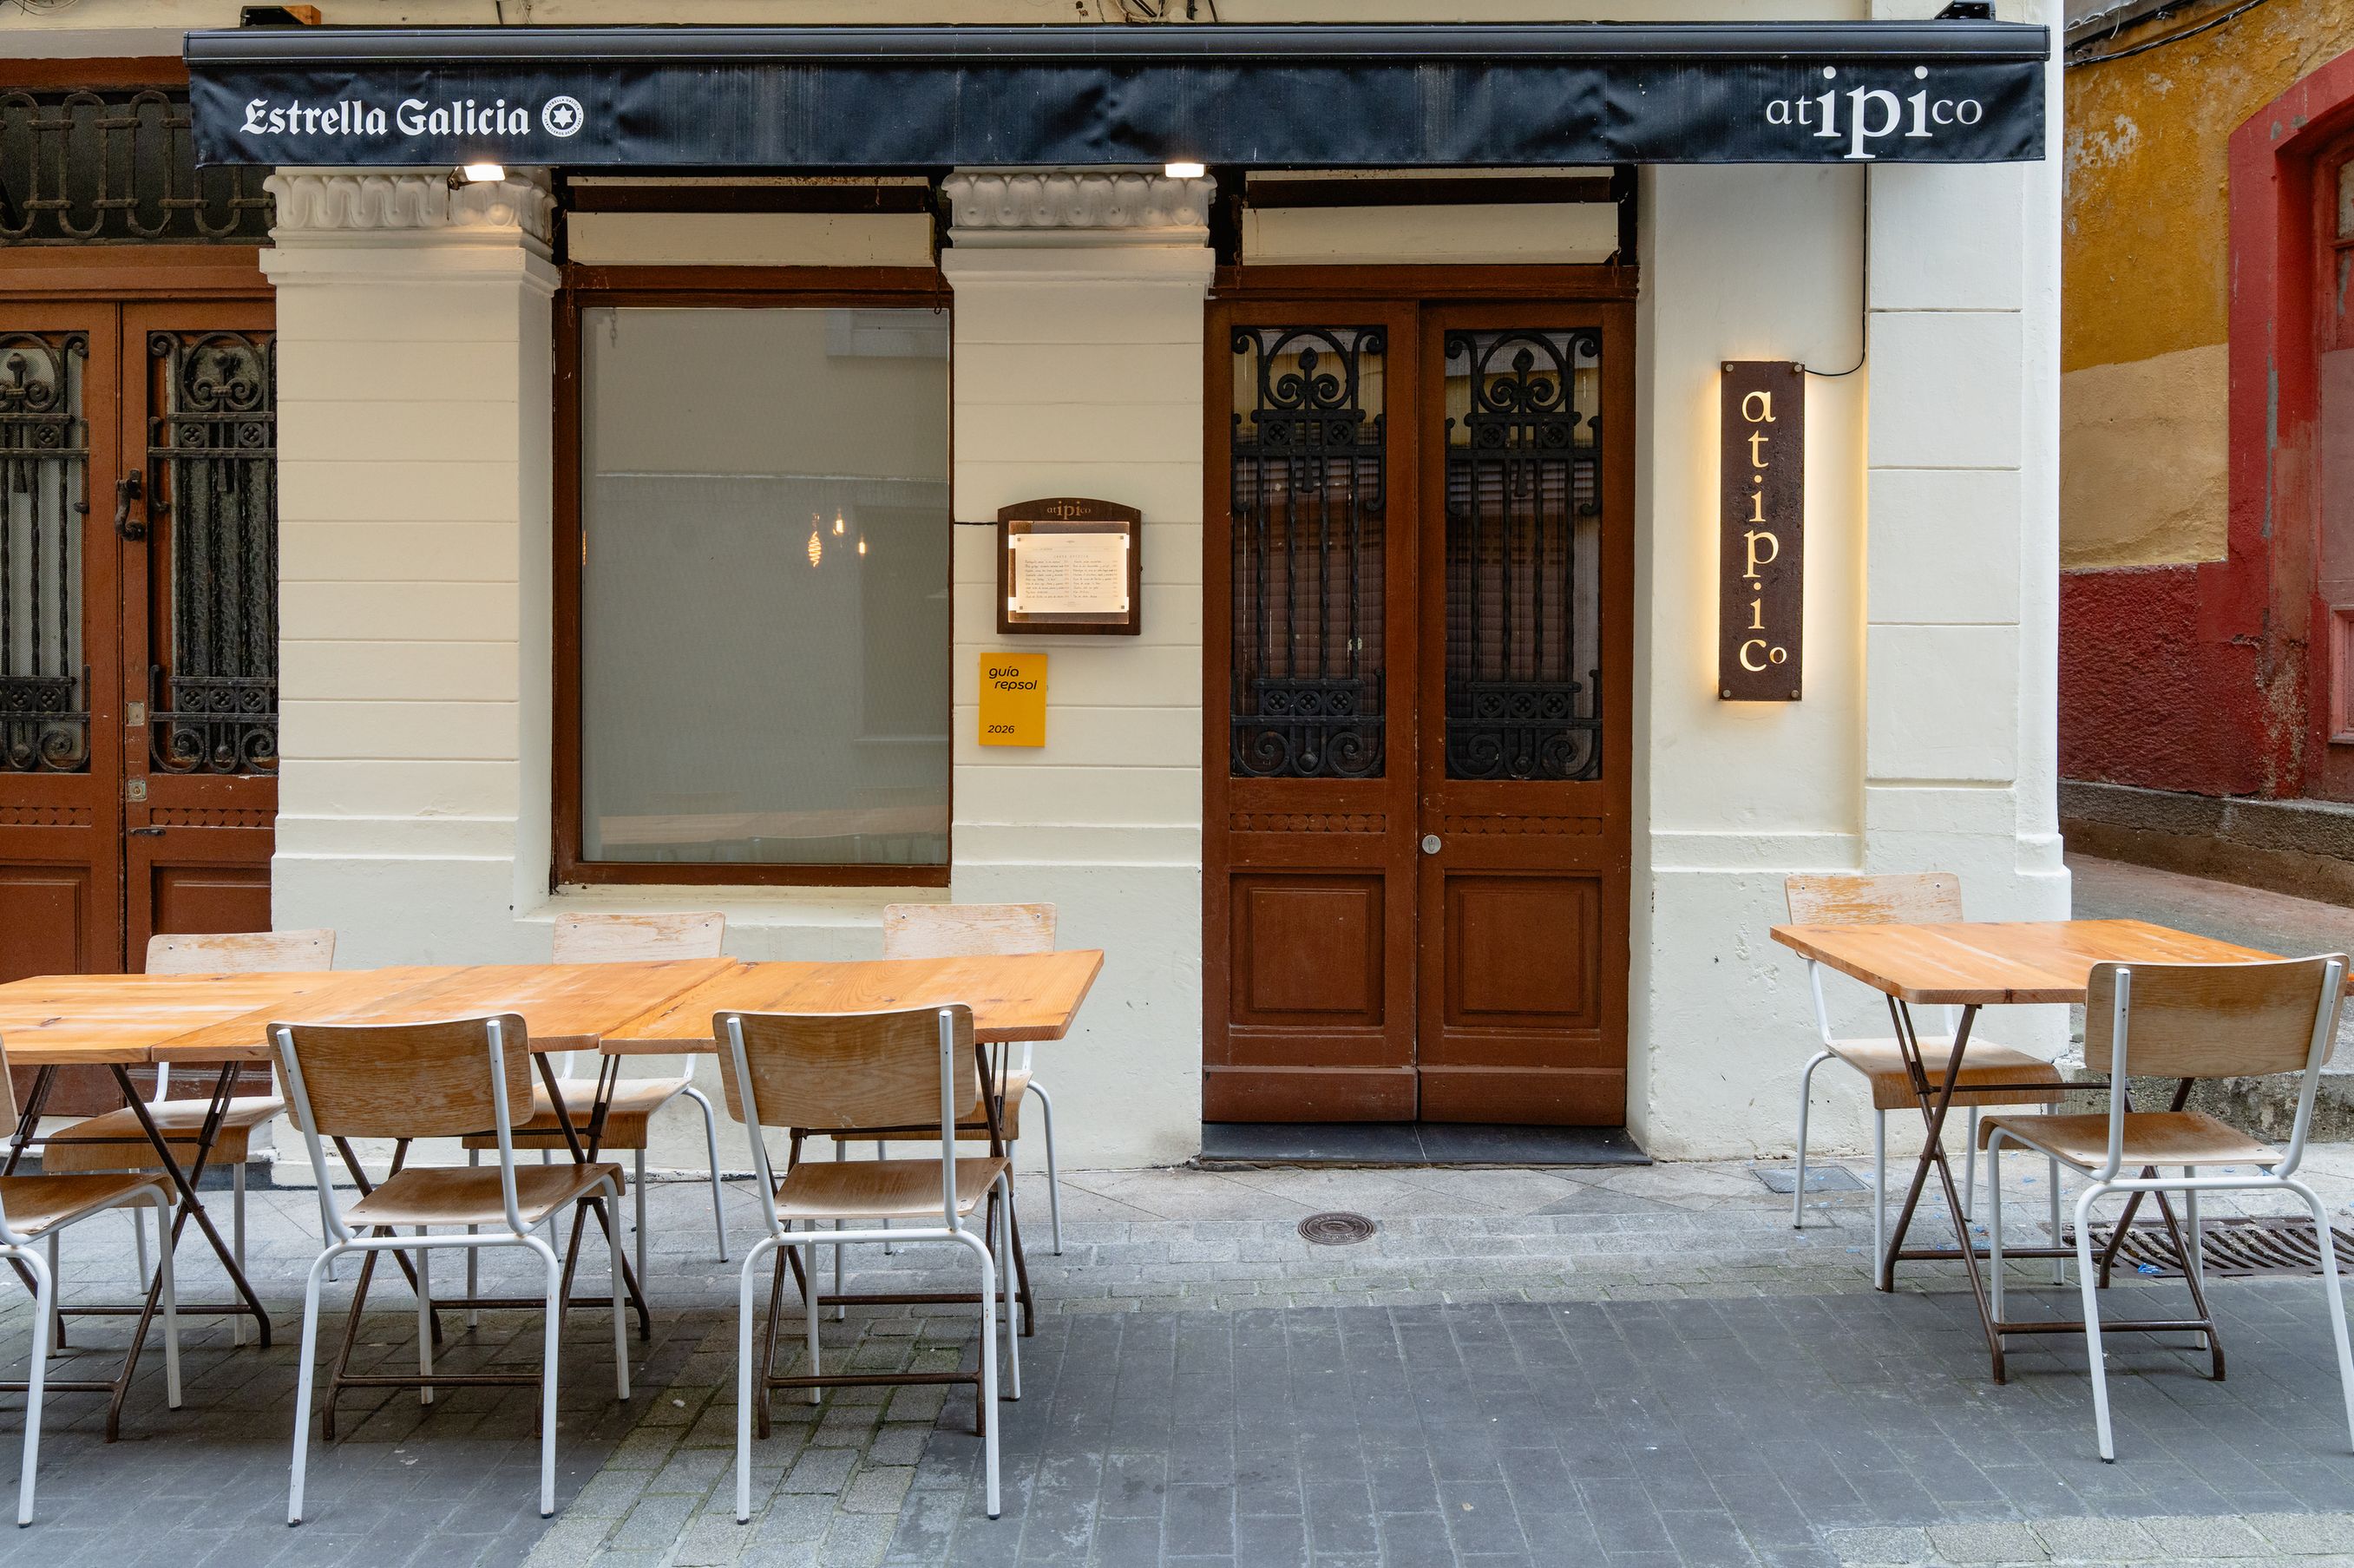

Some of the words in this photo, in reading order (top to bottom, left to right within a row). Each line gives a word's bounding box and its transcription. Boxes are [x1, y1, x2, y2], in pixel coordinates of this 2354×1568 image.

[239, 98, 388, 136] Estrella
[397, 97, 531, 137] Galicia
[1766, 66, 1983, 159] atipico
[1046, 501, 1092, 520] atipico
[1739, 390, 1787, 672] atipico
[988, 666, 1020, 679] guía
[994, 680, 1038, 692] repsol
[987, 725, 1015, 734] 2026
